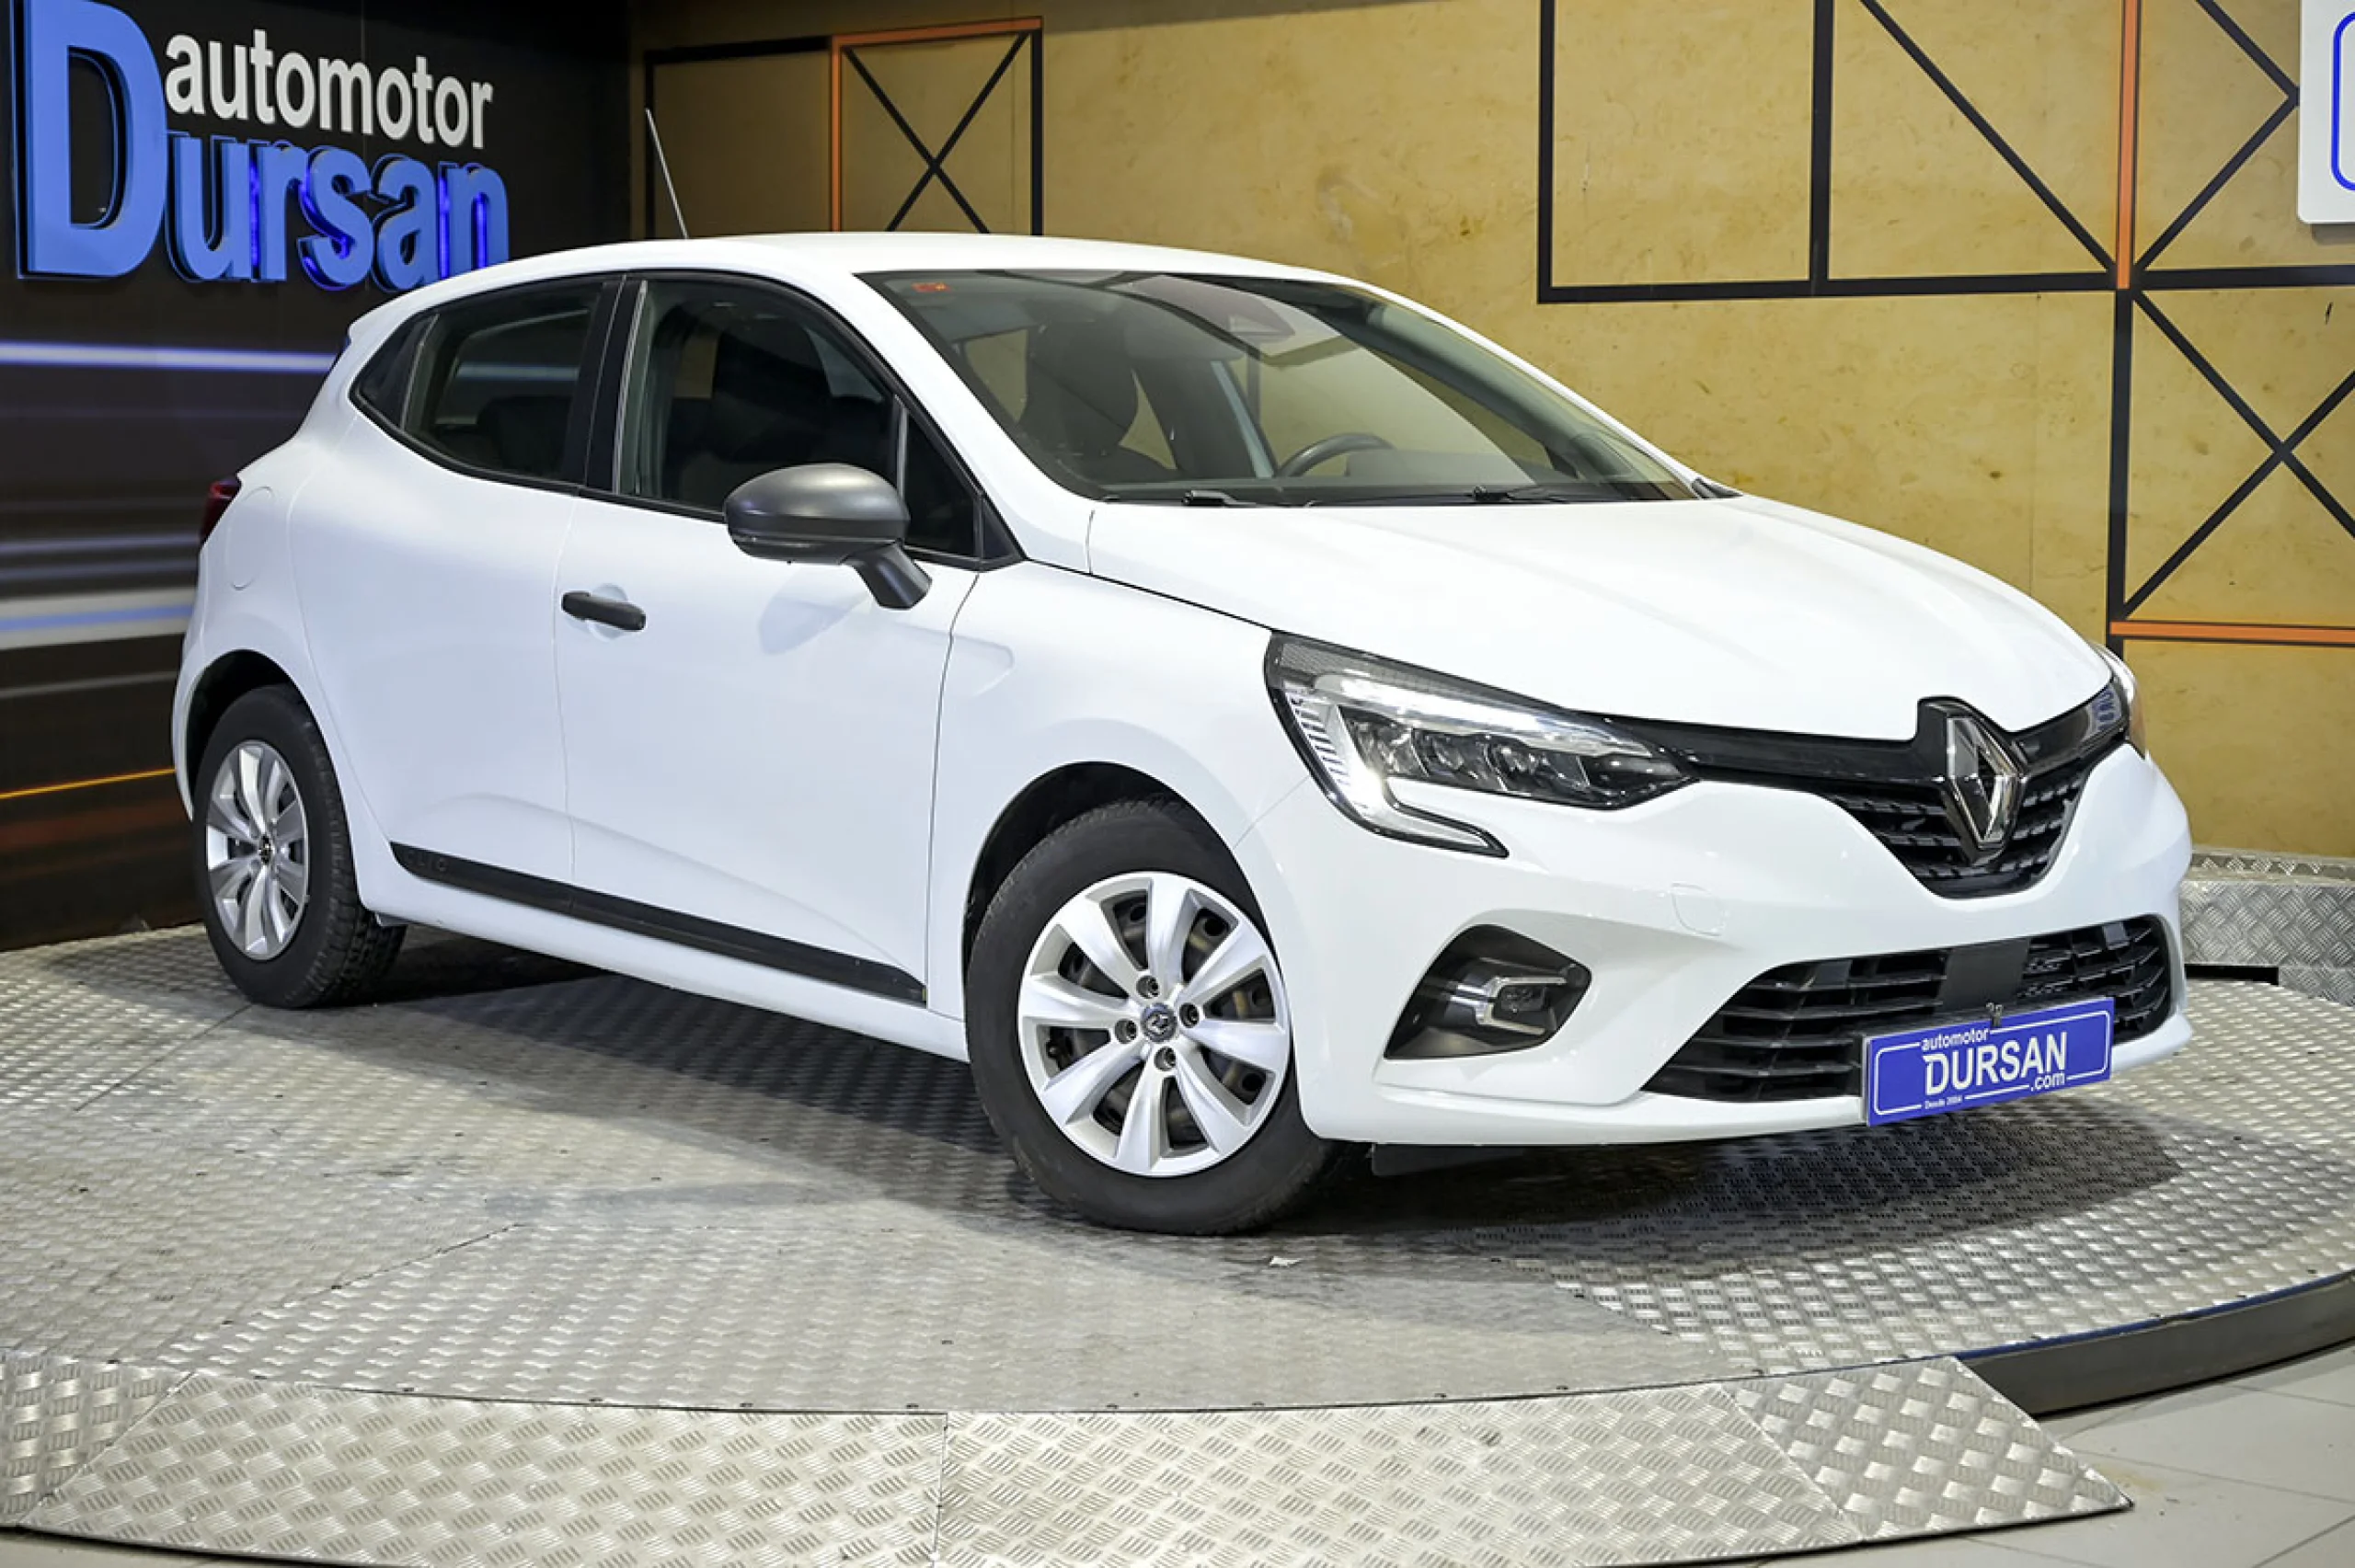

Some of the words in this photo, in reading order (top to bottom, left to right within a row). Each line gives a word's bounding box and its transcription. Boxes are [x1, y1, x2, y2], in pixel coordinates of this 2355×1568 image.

[166, 29, 493, 148] automotor
[15, 0, 509, 291] Dursan
[1921, 1028, 1989, 1050] automotor
[1923, 1032, 2067, 1095] DURSAN
[2030, 1071, 2065, 1092] .com
